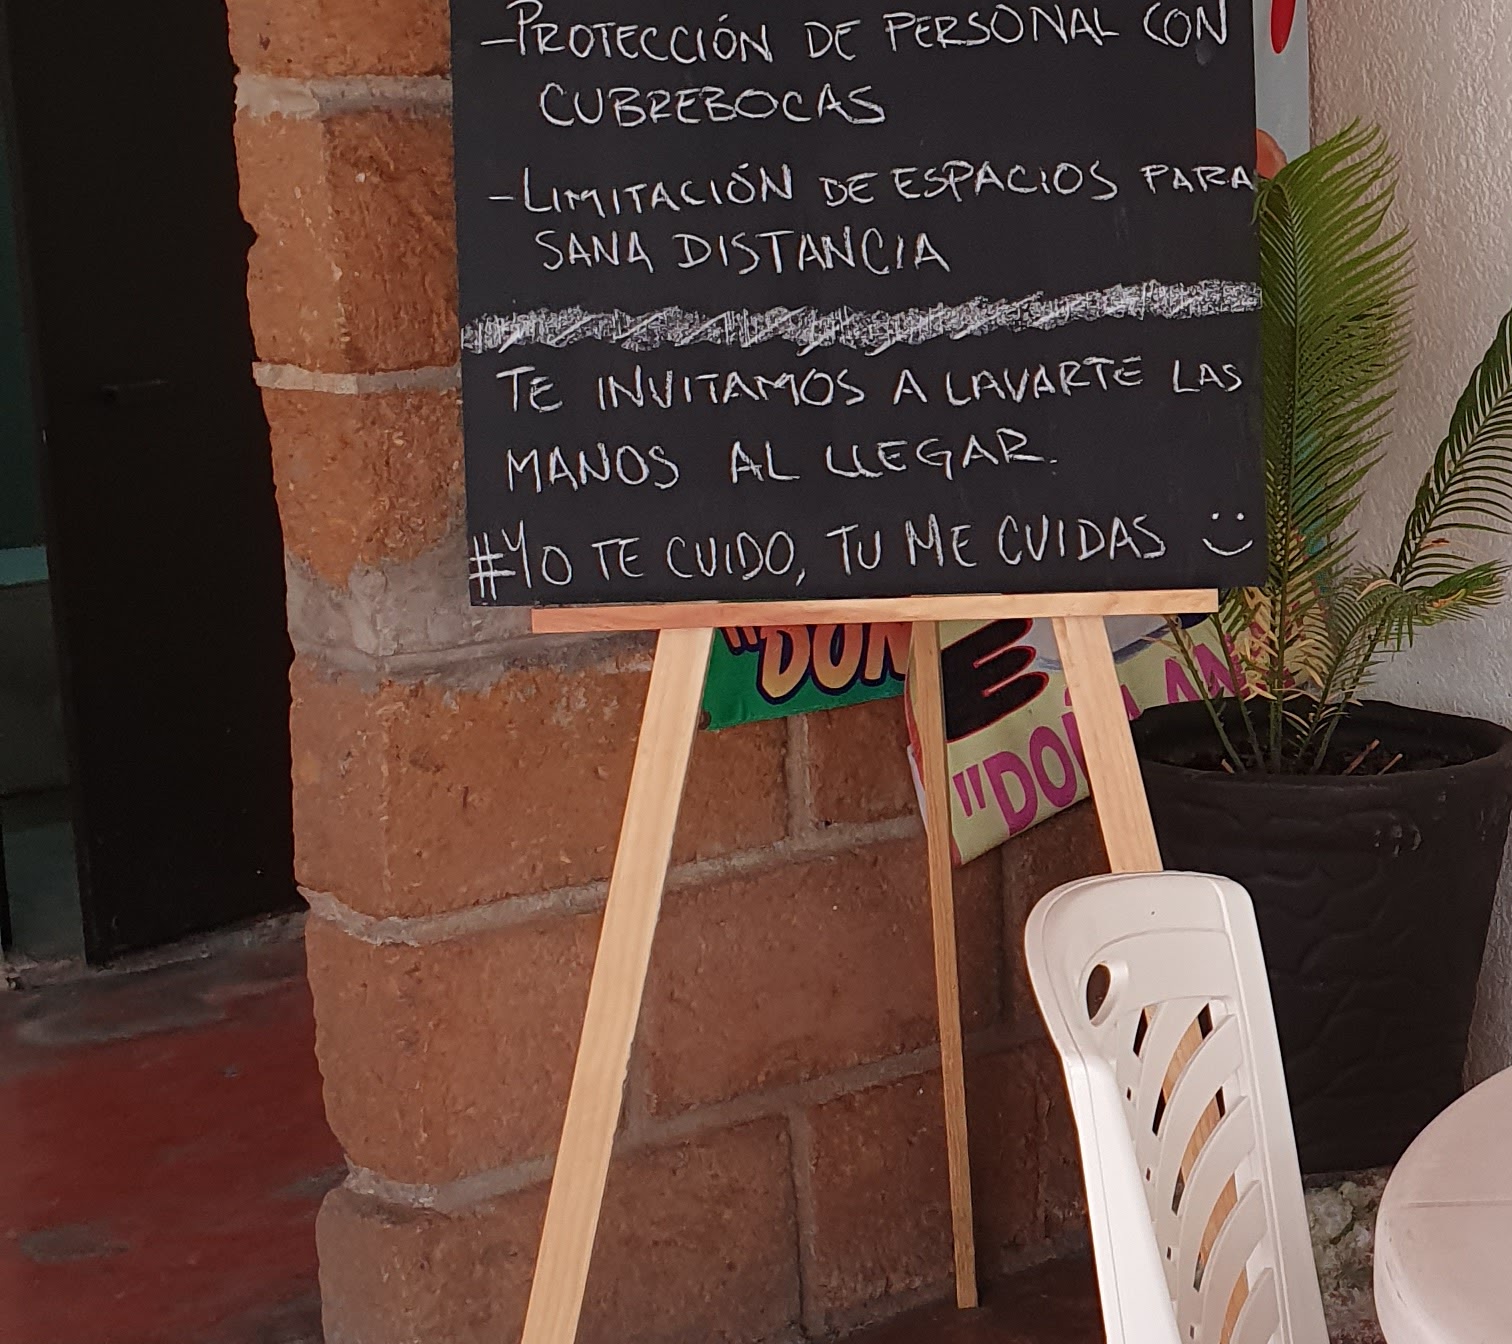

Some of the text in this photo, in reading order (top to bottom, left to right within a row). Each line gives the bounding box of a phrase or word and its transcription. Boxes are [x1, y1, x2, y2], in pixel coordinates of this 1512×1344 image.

[803, 18, 862, 62] DE
[881, 2, 1121, 53] PERSONAL
[538, 81, 887, 128] CUBREBOCAS
[821, 171, 879, 208] DE
[892, 159, 1119, 202] ESPACIOS
[1140, 161, 1256, 196] PARA
[532, 224, 952, 276] SANA DISTANCIA
[495, 354, 1244, 414] TE INVITAMOS A LAVARTE LAS
[505, 441, 682, 494] MANOS
[729, 439, 801, 485] AL
[590, 536, 645, 582] TE
[664, 529, 807, 587] CUIDO,
[825, 523, 883, 576] TU
[904, 512, 978, 568] ME
[989, 513, 1167, 566] CUIDAS
